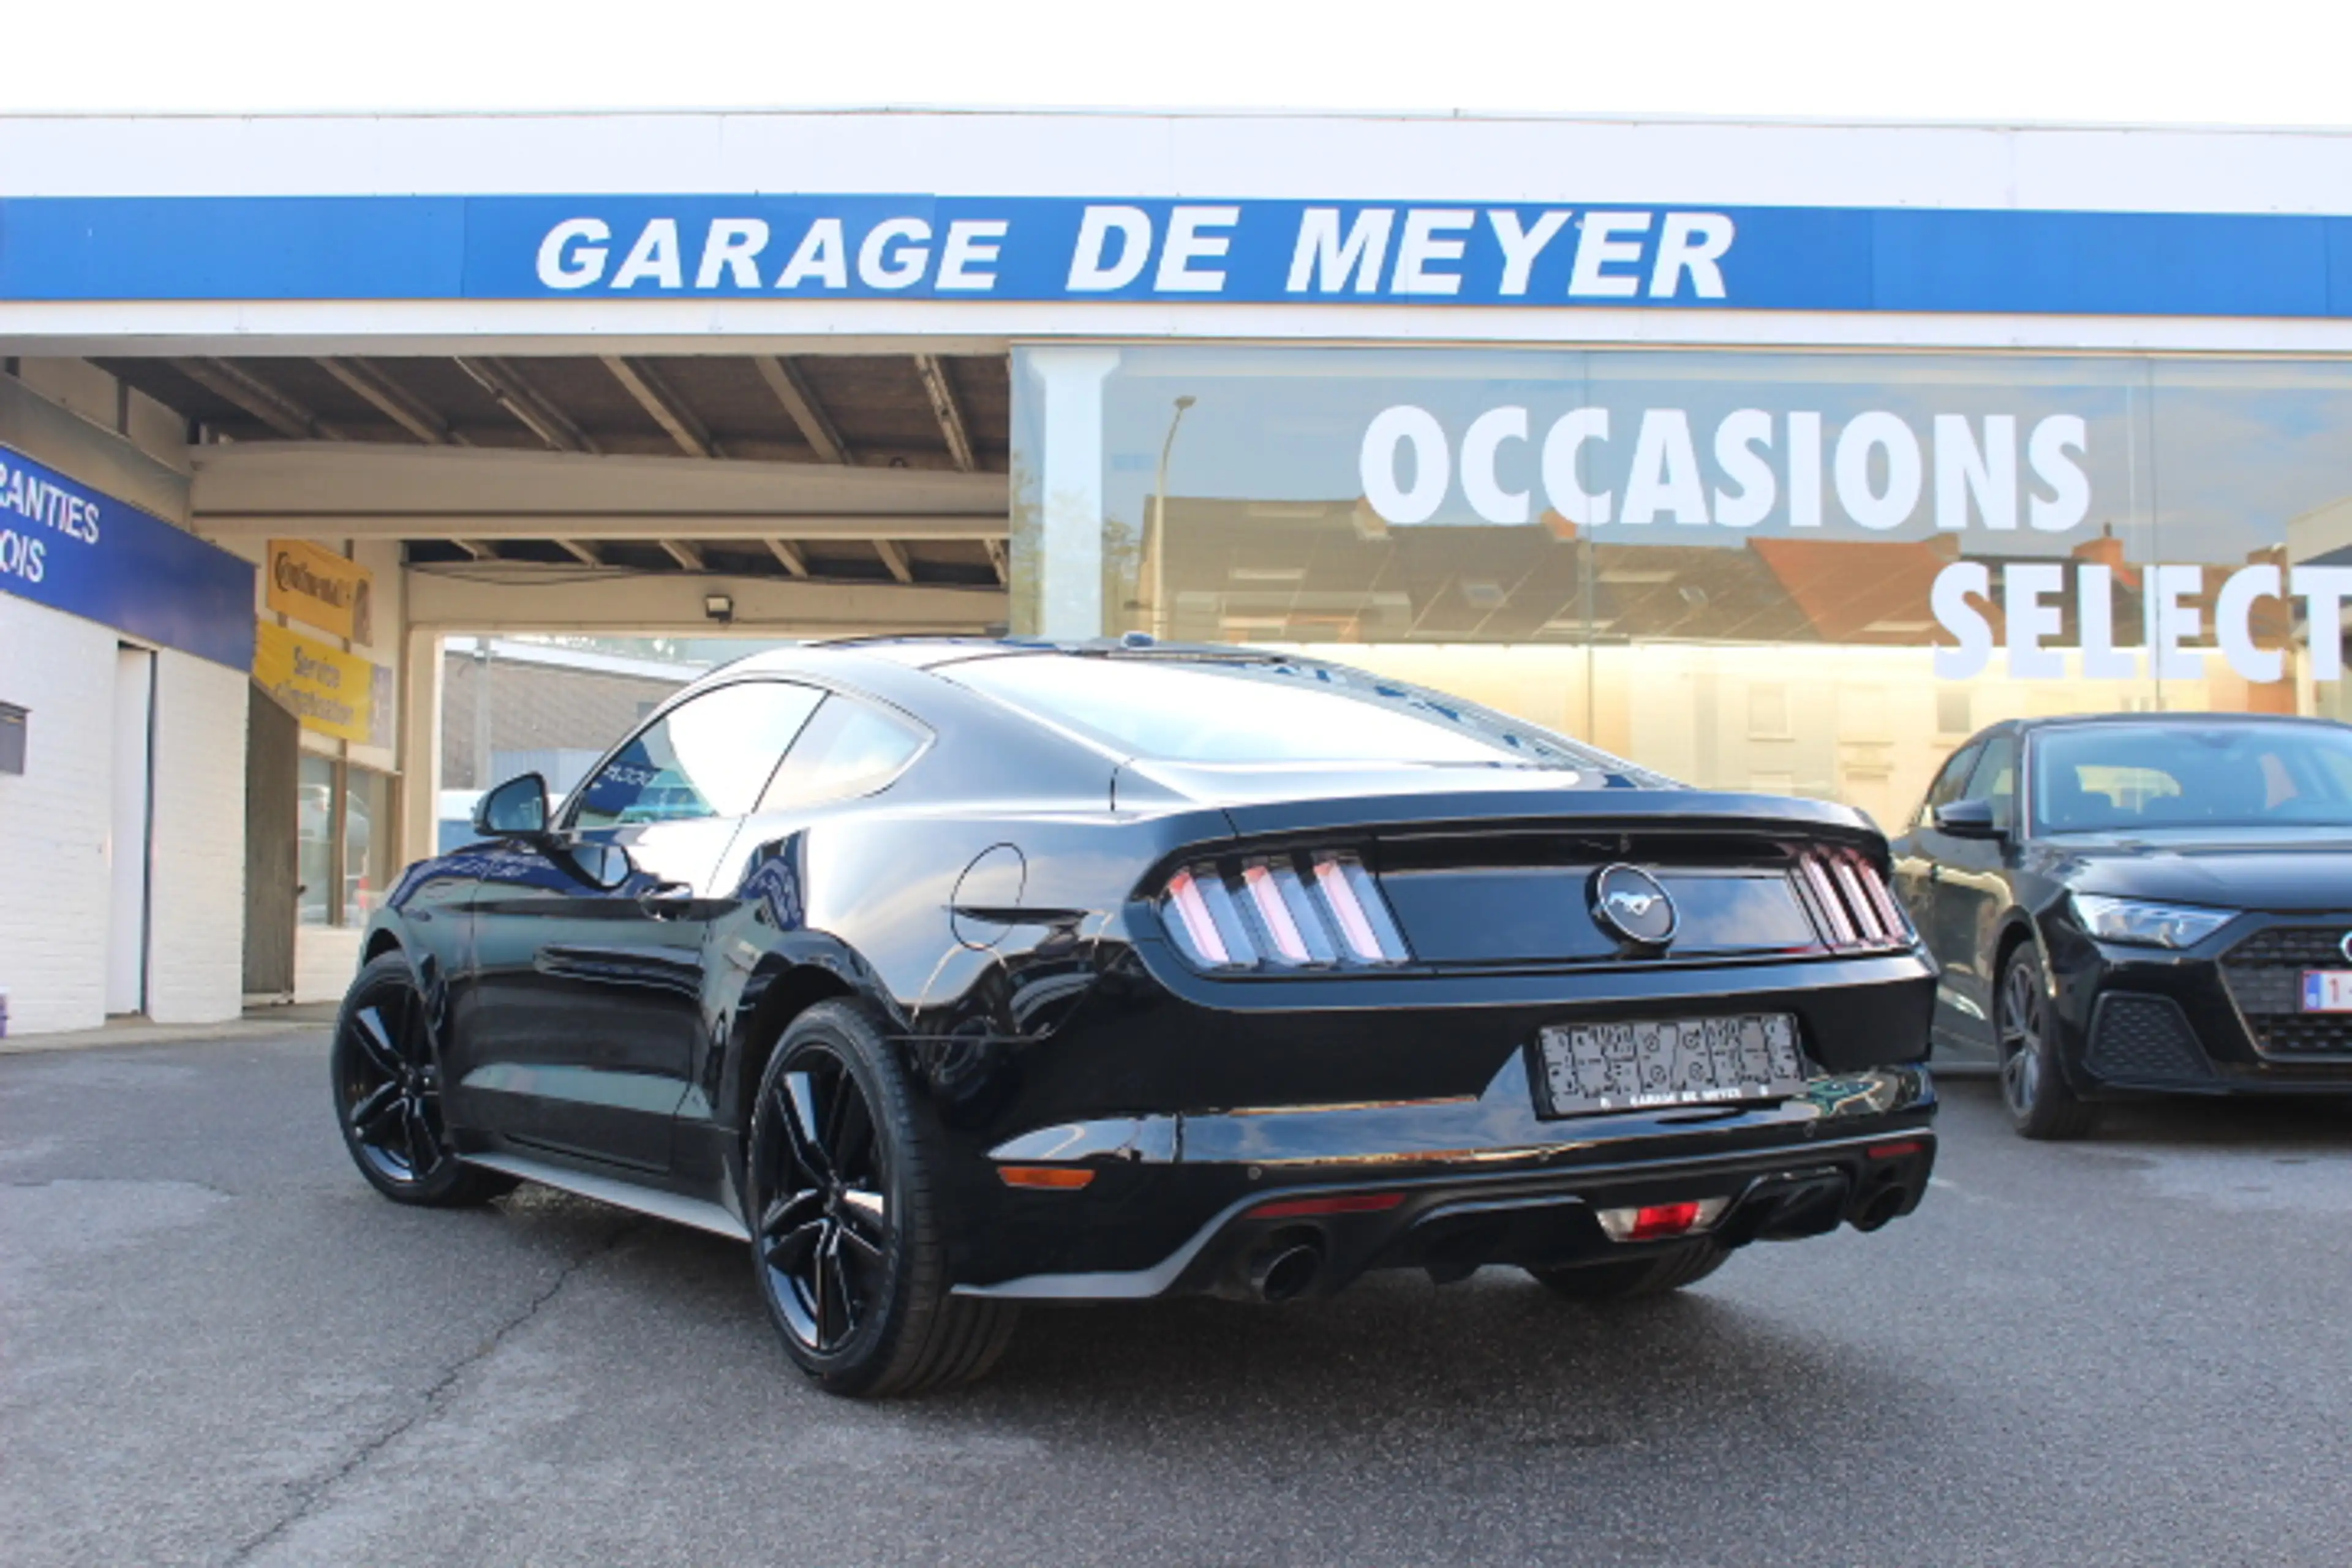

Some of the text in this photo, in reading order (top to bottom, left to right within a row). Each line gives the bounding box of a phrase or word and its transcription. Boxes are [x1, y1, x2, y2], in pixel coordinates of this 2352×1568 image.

[537, 205, 1735, 298] GARAGE DE MEYER
[1359, 405, 2091, 532] OCCASIONS
[1931, 560, 2352, 683] SELECT
